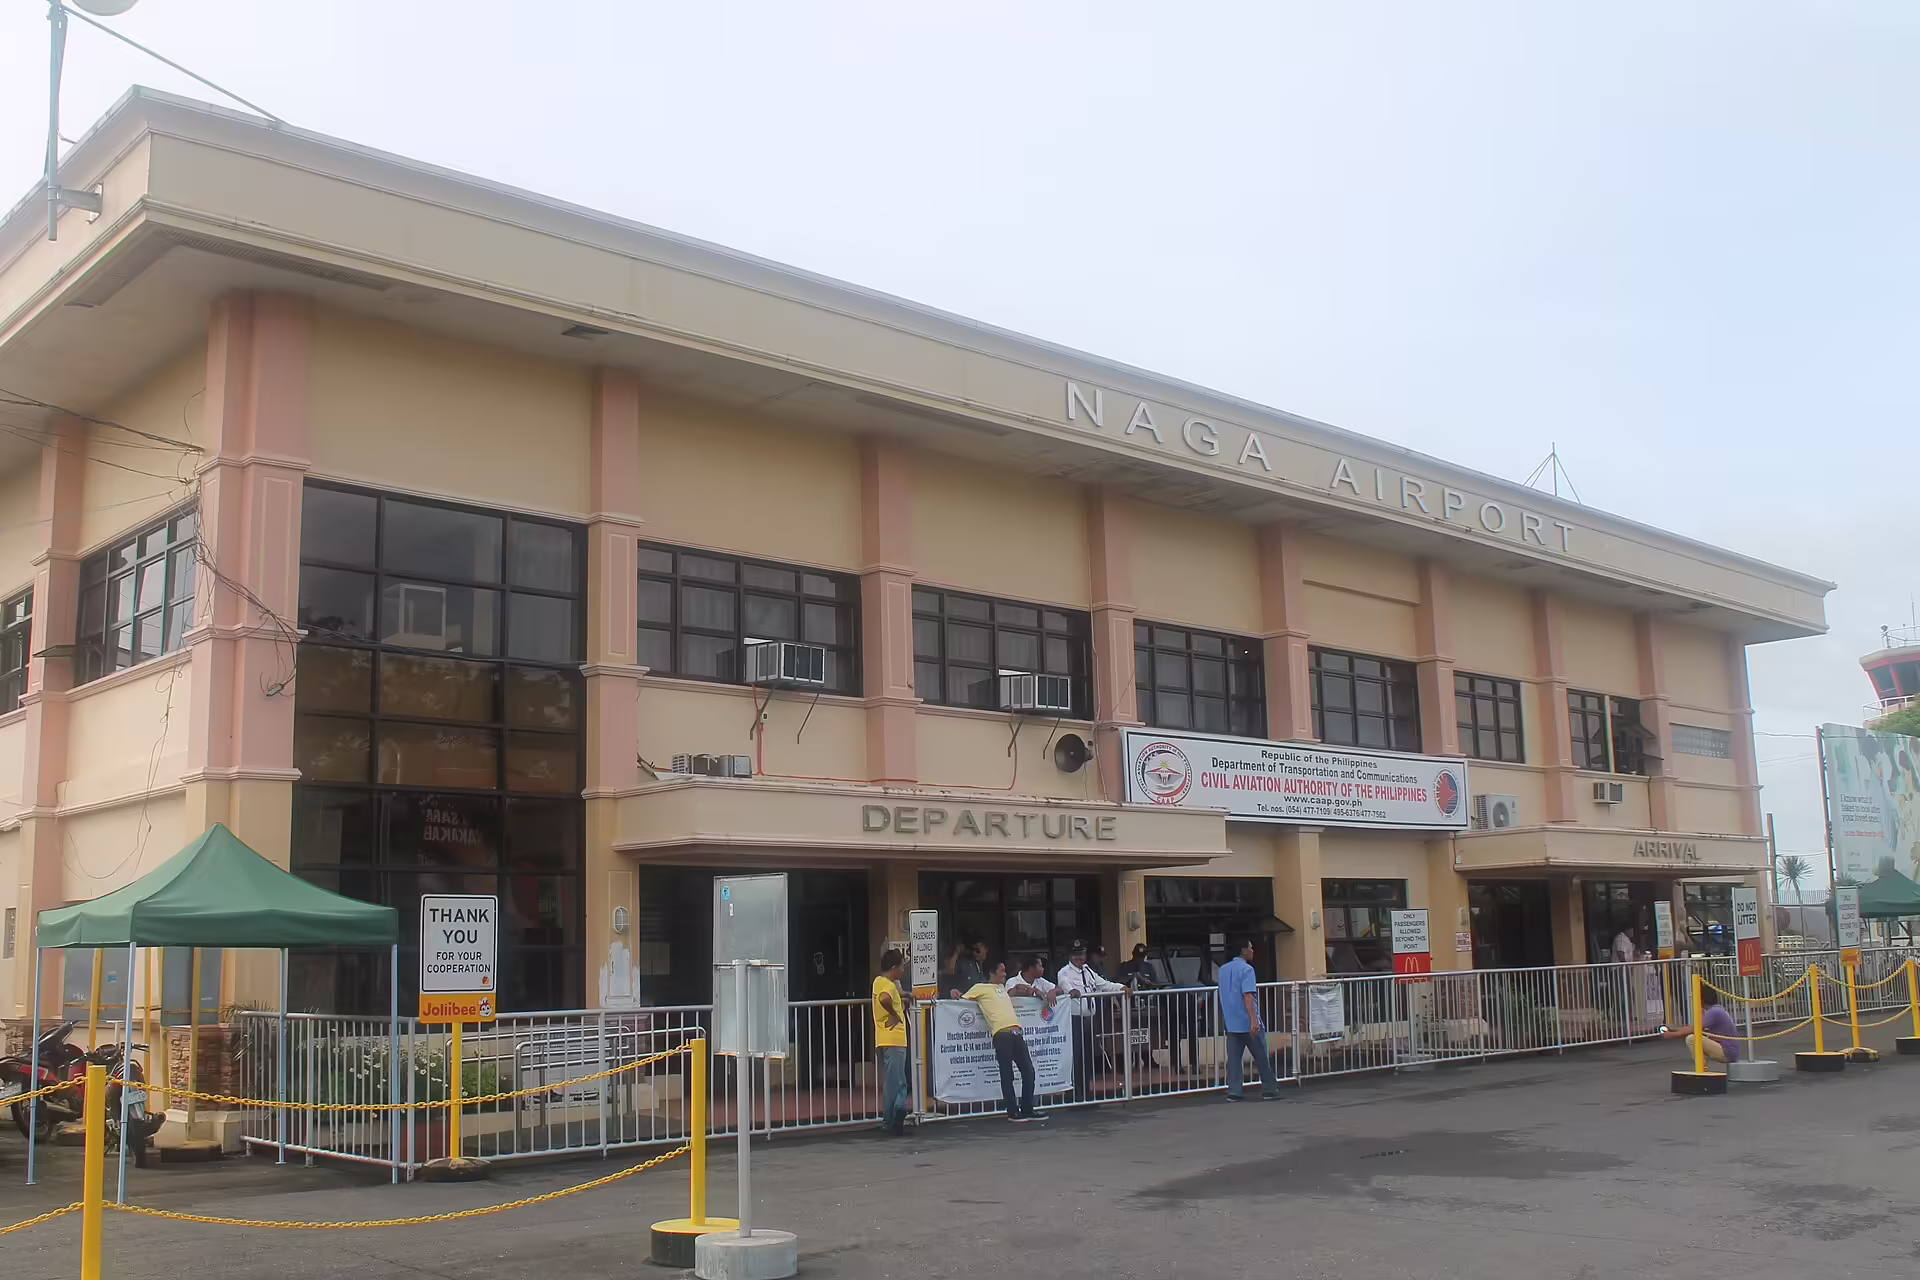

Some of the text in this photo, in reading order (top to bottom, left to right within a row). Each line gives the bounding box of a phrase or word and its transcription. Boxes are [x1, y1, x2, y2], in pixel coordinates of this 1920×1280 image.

[1067, 381, 1574, 552] NAGA AIRPORT
[1261, 750, 1377, 769] Republic of the Philippines
[1212, 757, 1417, 784] Department of Transportation and Communications
[1201, 771, 1230, 788] CIVIL
[1232, 774, 1281, 793] AVIATION
[1284, 778, 1338, 797] AUTHORITY
[1341, 782, 1352, 797] OF
[1355, 783, 1373, 799] THE
[1375, 785, 1427, 802] PHILIPPINES
[1284, 795, 1362, 808] www.caap.gov.ph
[1257, 804, 1269, 812] Tel.
[1271, 805, 1284, 813] nos.
[1286, 805, 1301, 815] (054)
[862, 804, 1117, 841] DEPARTURE
[1633, 840, 1701, 860] ARRIVAL
[1737, 901, 1756, 912] DO NOT
[429, 908, 489, 923] THANK
[1737, 913, 1757, 925] LITTER
[442, 929, 478, 944] YOU
[436, 951, 482, 961] FOR YOUR
[427, 964, 491, 973] COOPERATION
[423, 1001, 477, 1017] Jollibee
